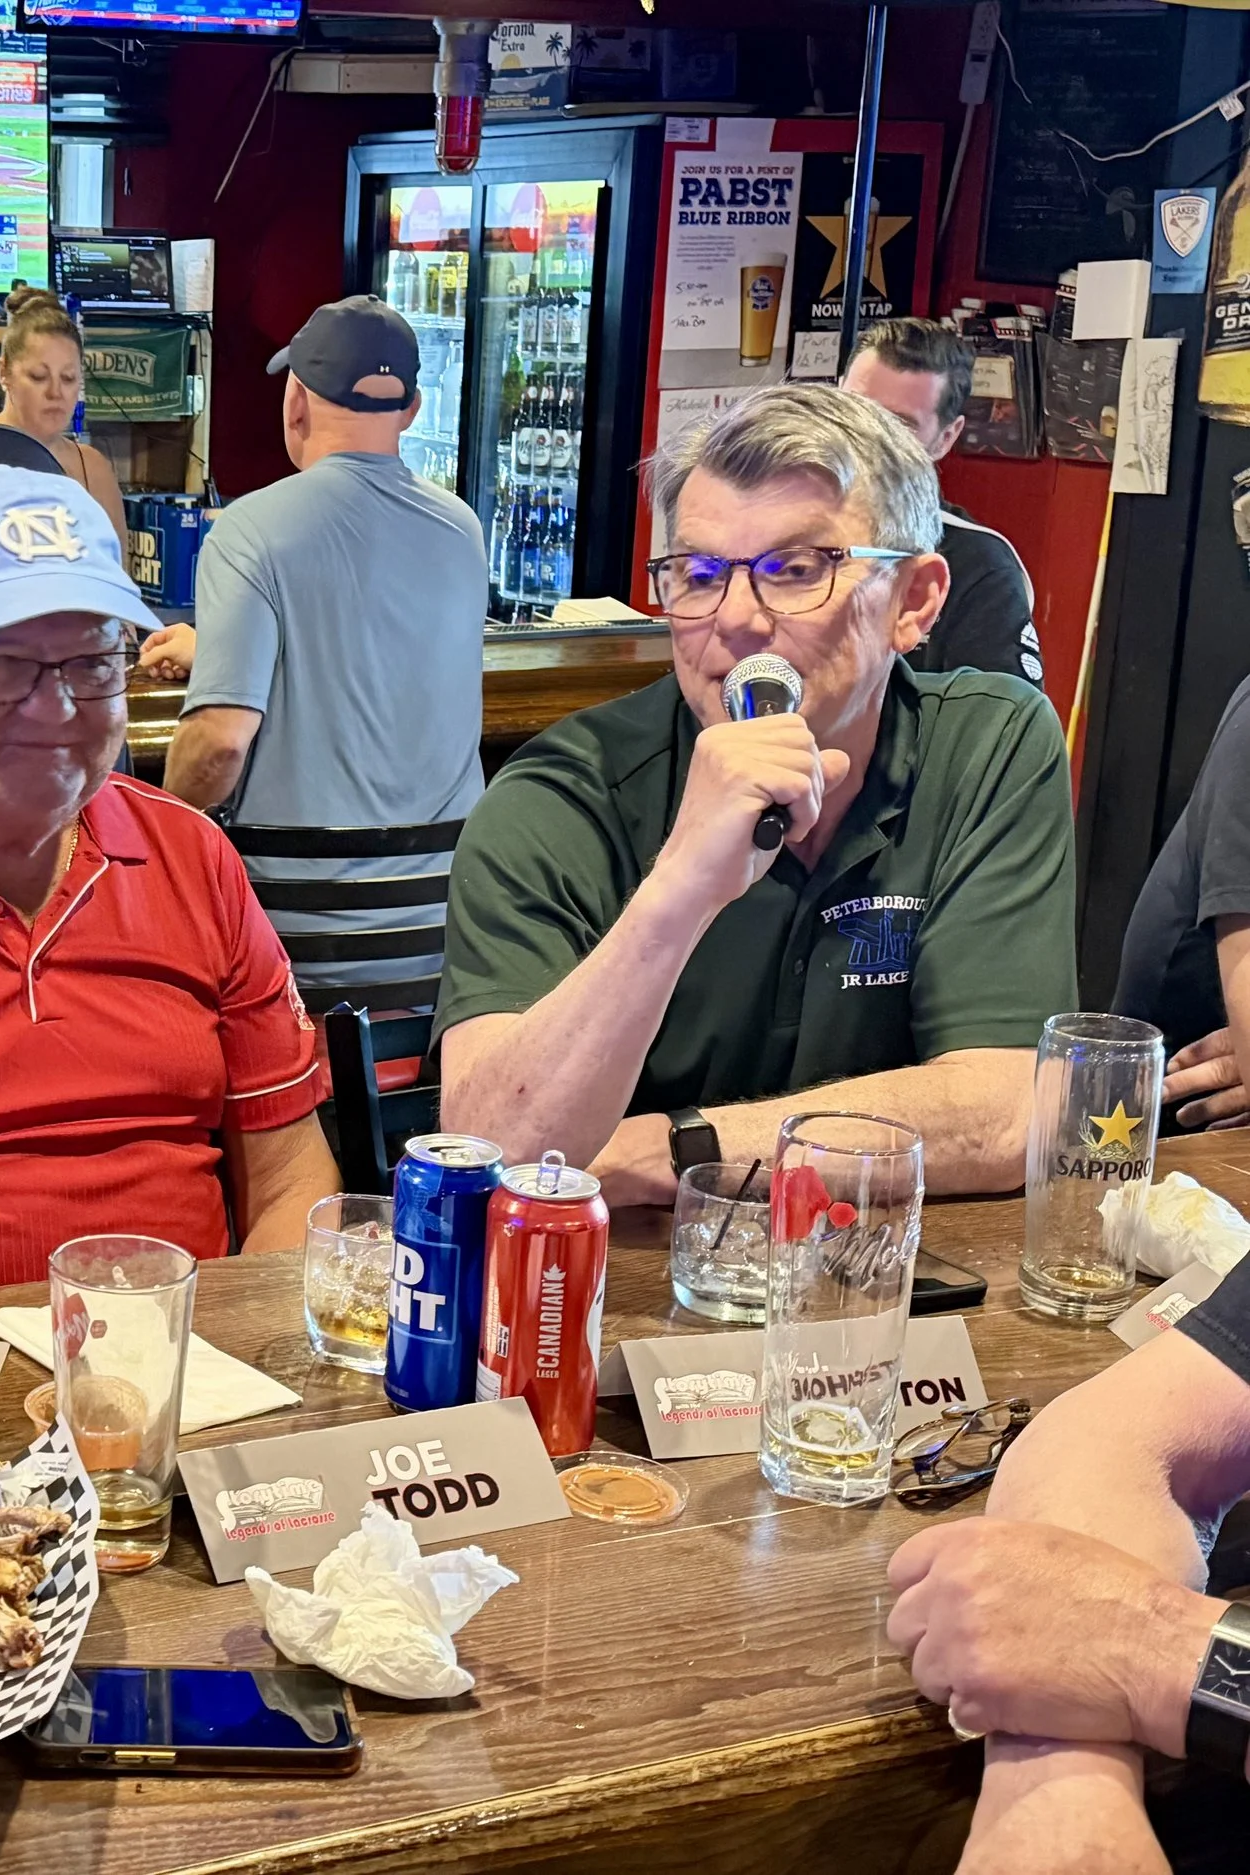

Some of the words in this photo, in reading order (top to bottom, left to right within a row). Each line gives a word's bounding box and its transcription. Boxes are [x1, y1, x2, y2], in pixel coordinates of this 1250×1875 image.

[682, 166, 706, 175] JOIN
[709, 166, 722, 175] US
[724, 166, 744, 175] FOR
[746, 166, 754, 175] A
[757, 166, 780, 175] PINT
[678, 177, 793, 208] PABST
[678, 211, 721, 225] BLUE
[726, 211, 791, 225] RIBBON
[868, 303, 893, 316] TAP
[83, 351, 149, 377] OLDEN'S
[131, 555, 162, 586] GHT
[820, 895, 929, 924] PETERBOROU
[841, 974, 862, 989] JR
[865, 970, 910, 986] LAKE
[536, 1278, 567, 1369] CANADIAN
[536, 1370, 560, 1380] LAGER
[660, 1408, 704, 1424] legends
[706, 1406, 719, 1419] of
[720, 1404, 768, 1418] lacross
[365, 1439, 452, 1486] JOE
[371, 1472, 500, 1520] TODD
[224, 1519, 272, 1542] legends
[273, 1517, 288, 1532] of
[287, 1510, 336, 1530] lacrosse
